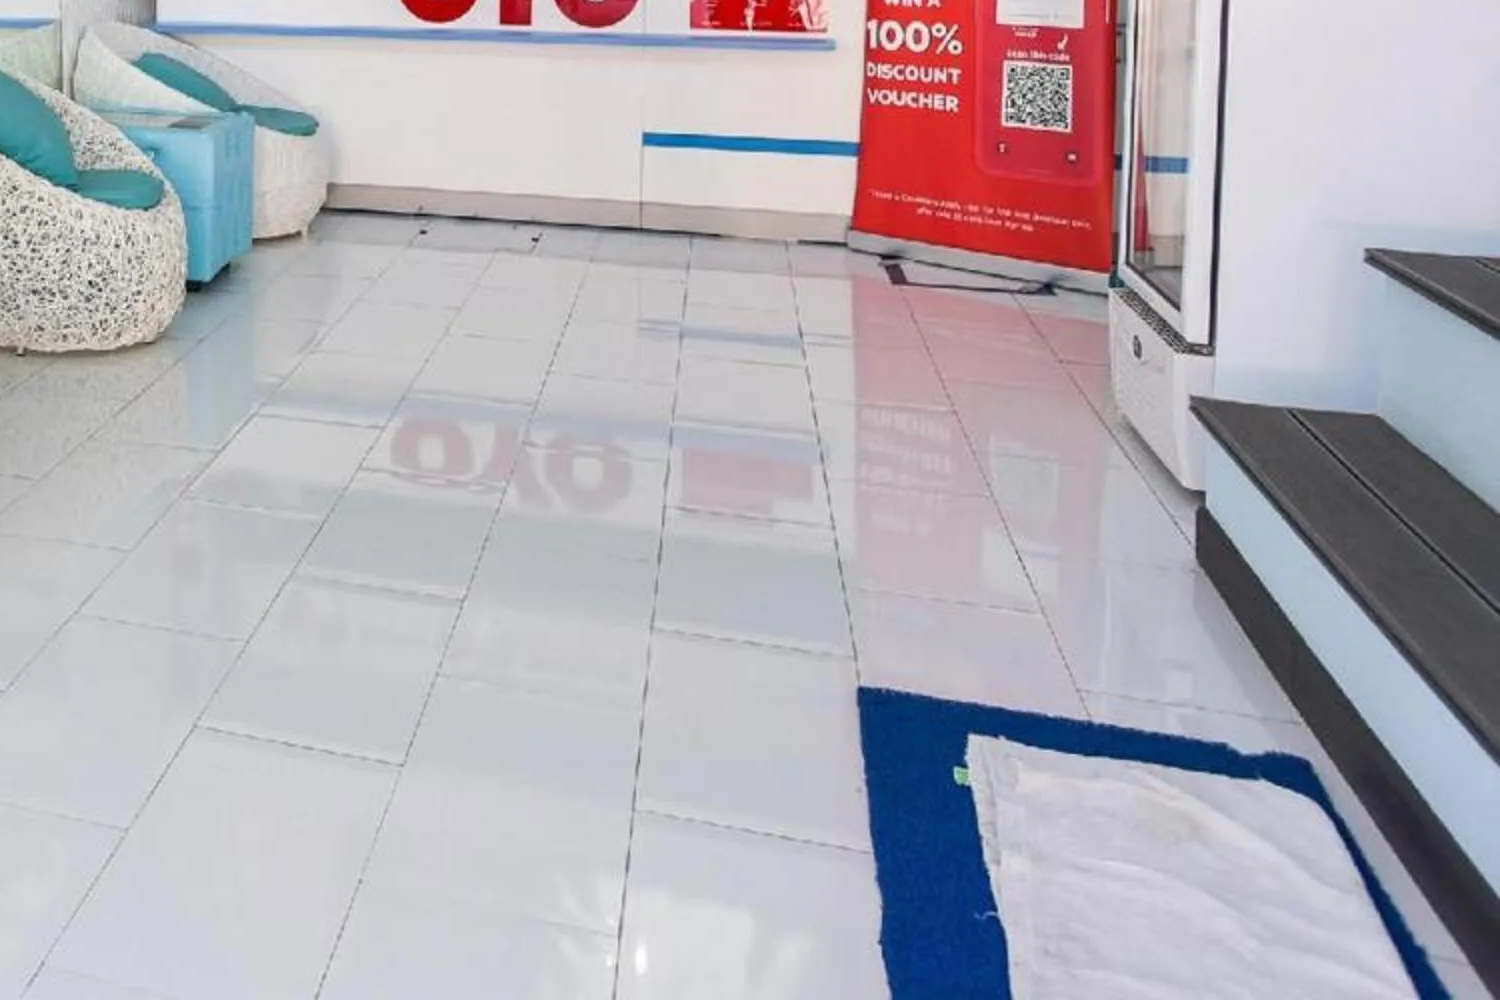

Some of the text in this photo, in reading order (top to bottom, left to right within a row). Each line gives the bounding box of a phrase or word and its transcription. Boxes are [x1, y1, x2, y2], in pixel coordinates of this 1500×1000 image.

[866, 18, 964, 56] 100%
[867, 61, 963, 85] DISCOUNT
[867, 87, 960, 114] VOUCHER
